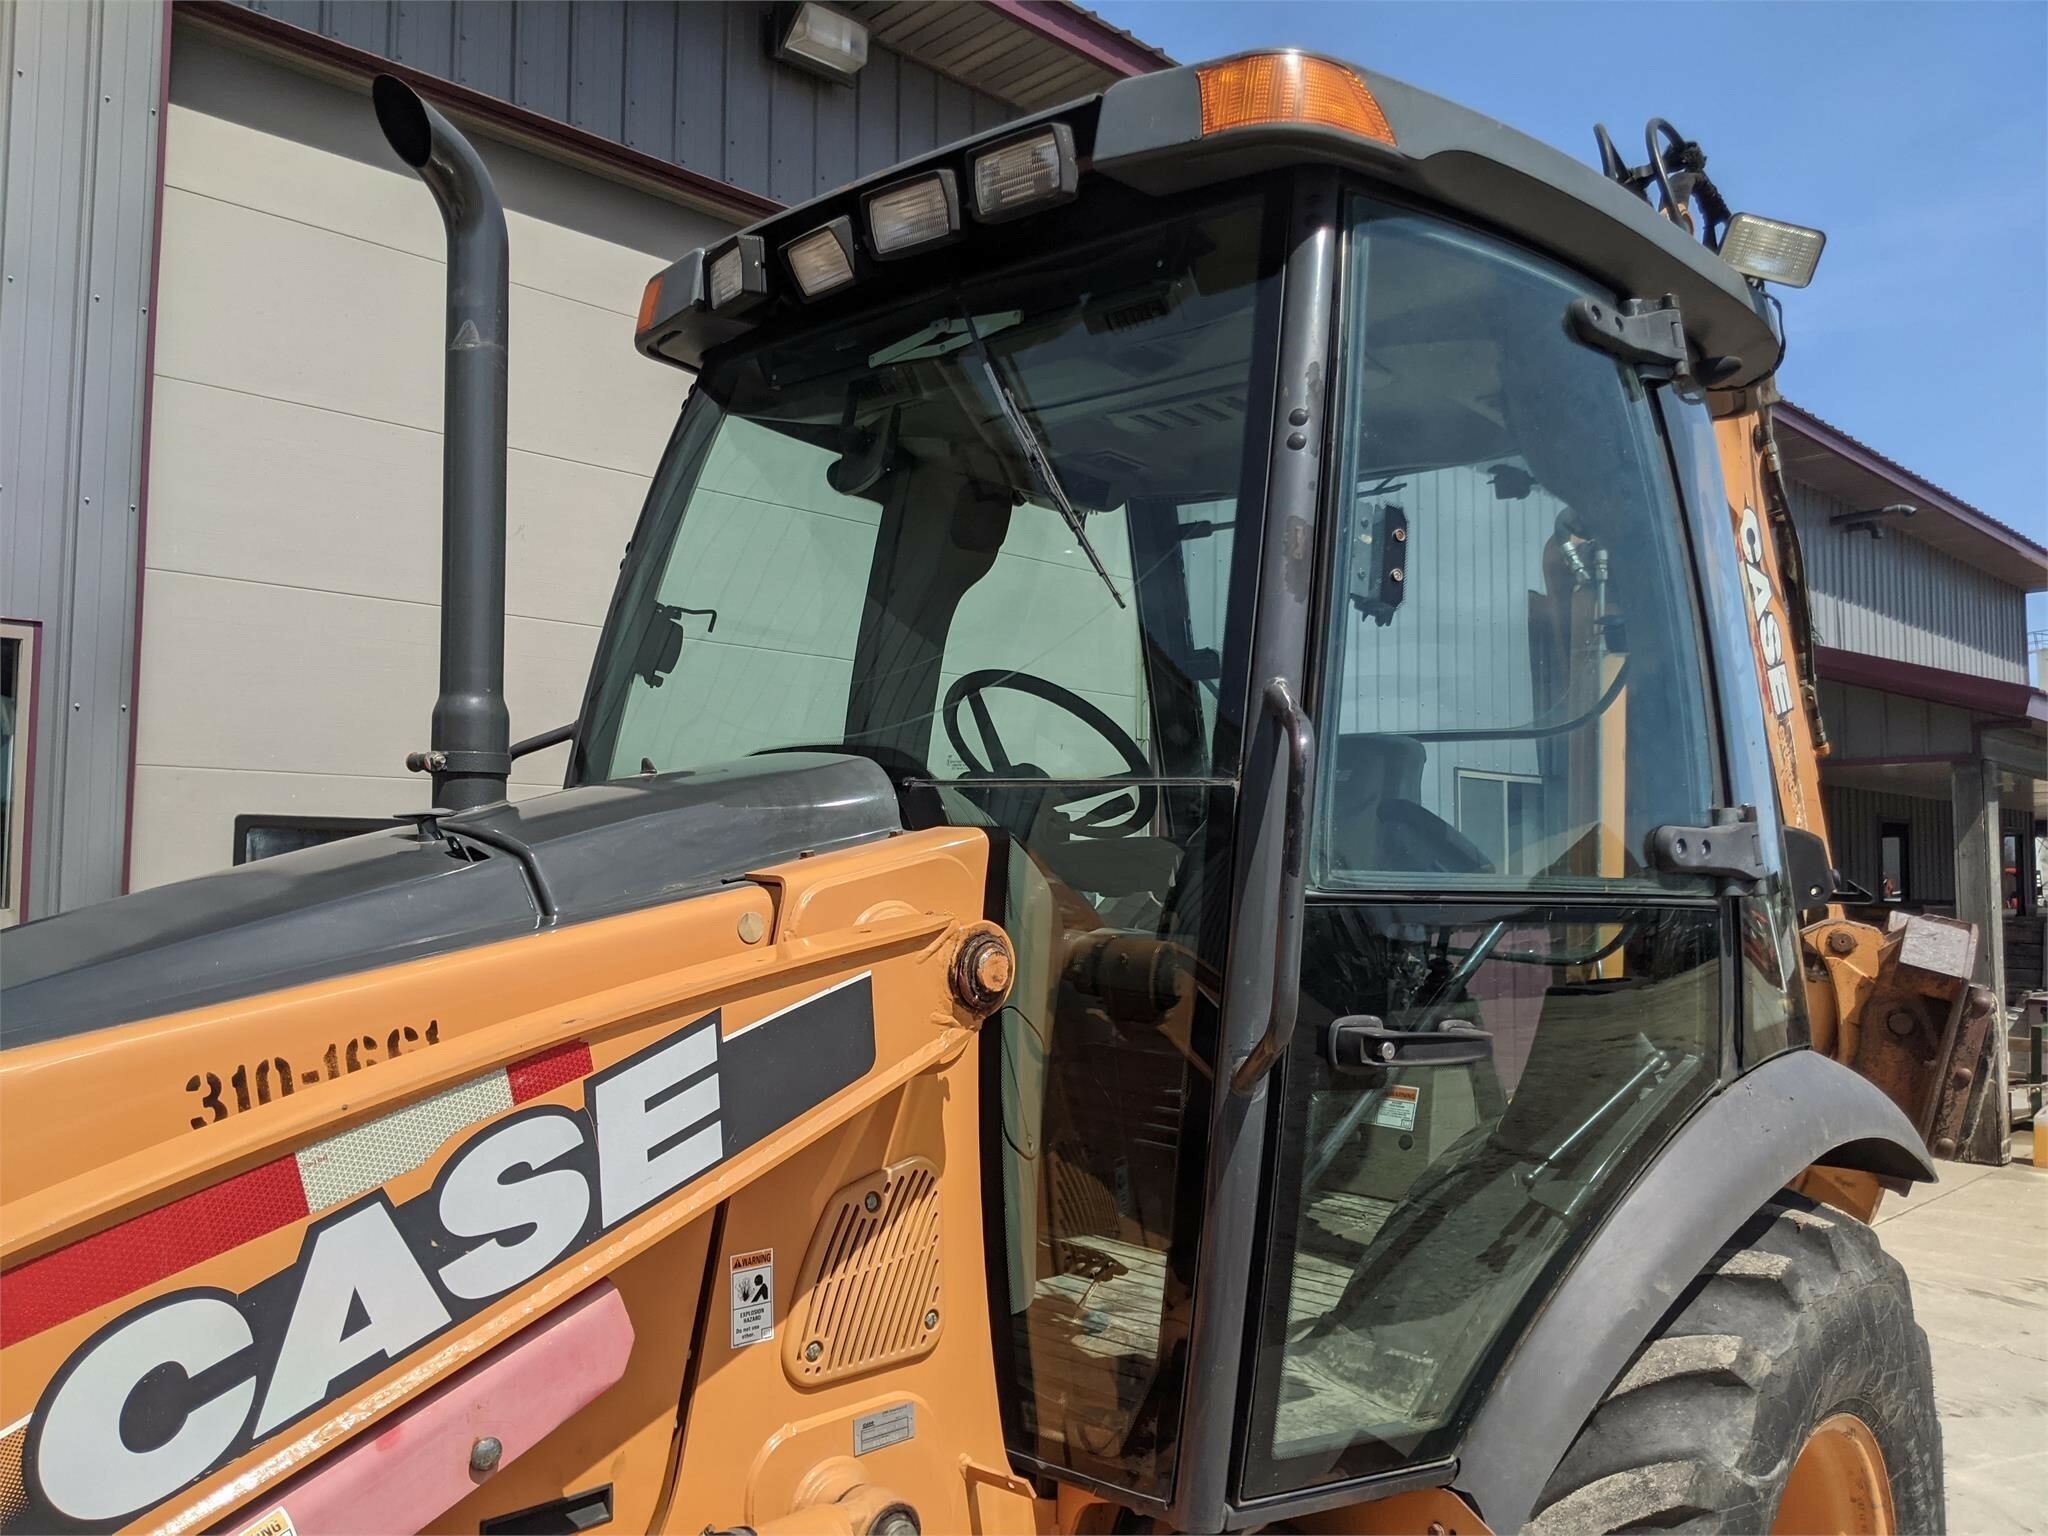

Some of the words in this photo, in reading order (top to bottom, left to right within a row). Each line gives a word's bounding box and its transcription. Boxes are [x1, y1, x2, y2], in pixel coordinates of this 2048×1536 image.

[1740, 508, 1793, 715] CASE
[38, 1024, 723, 1520] CASE
[741, 1253, 771, 1267] WARNING
